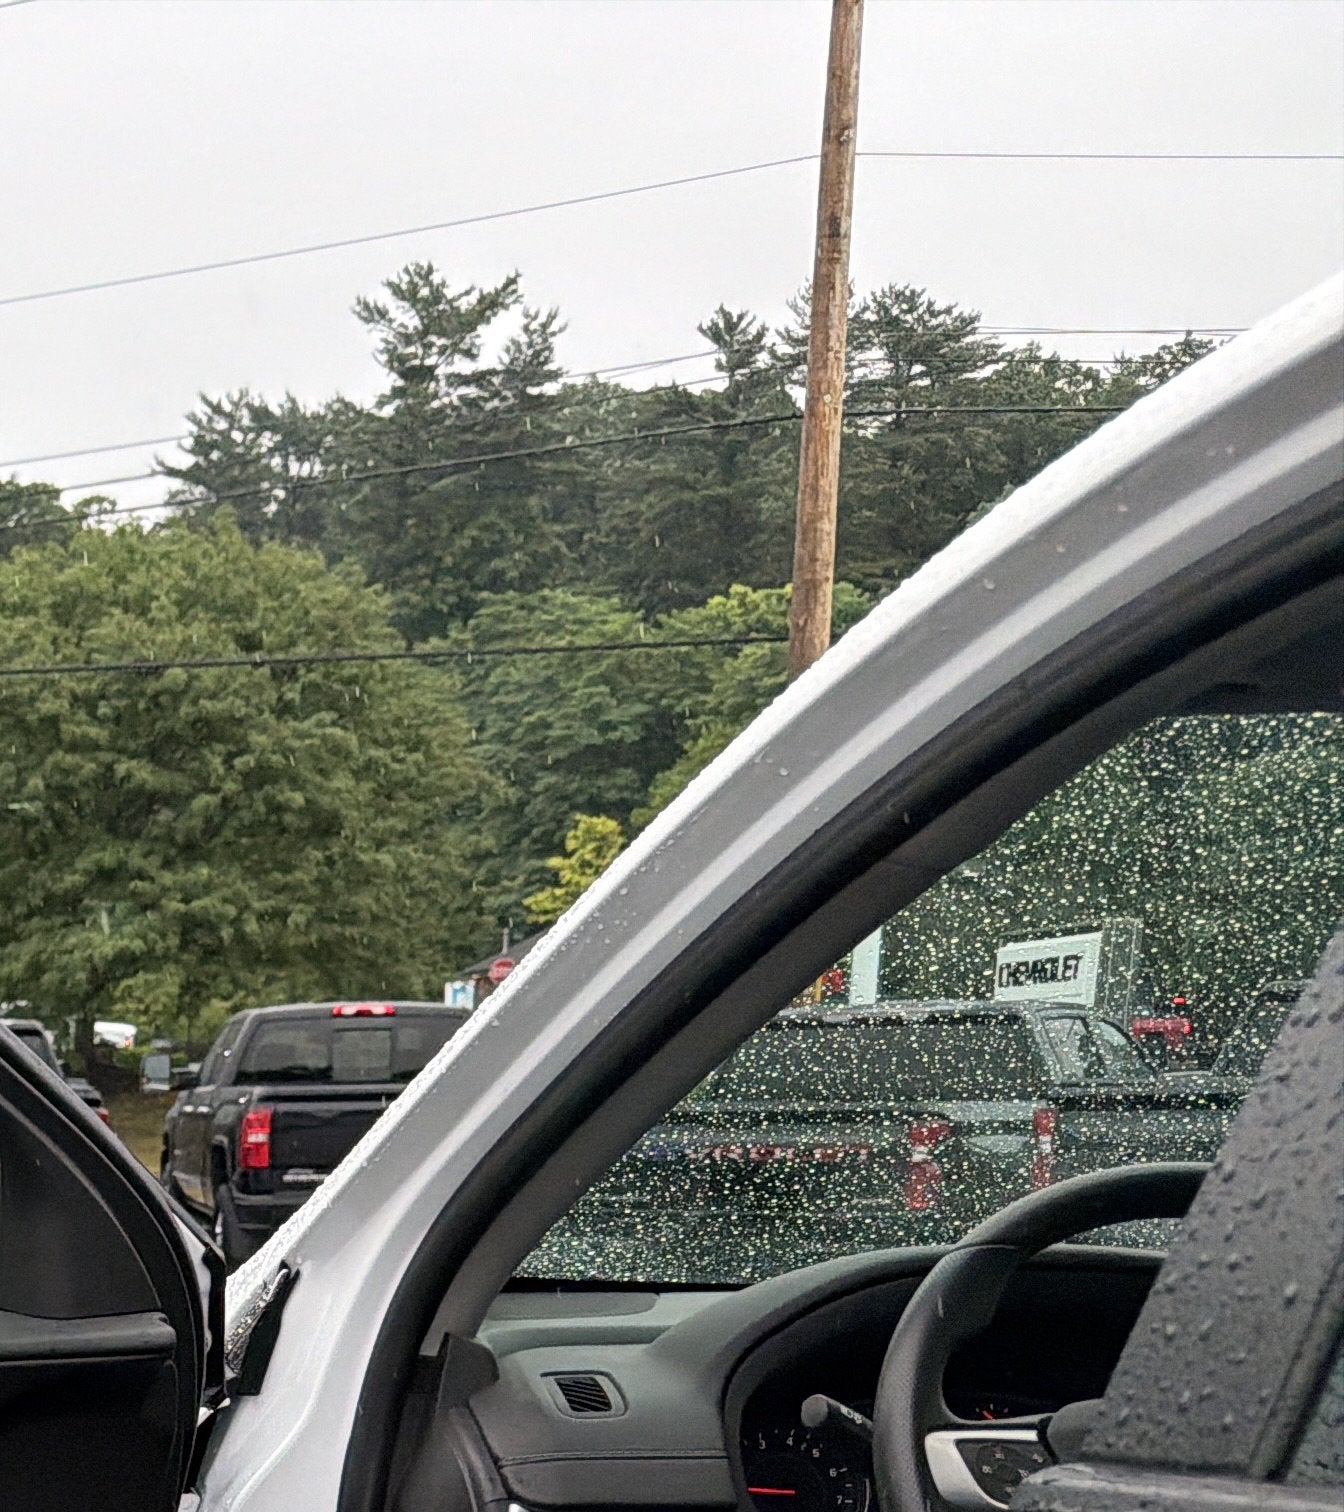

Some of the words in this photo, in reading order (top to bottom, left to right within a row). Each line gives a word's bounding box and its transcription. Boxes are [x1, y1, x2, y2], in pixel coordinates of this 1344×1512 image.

[759, 1440, 766, 1449] 3
[786, 1436, 793, 1446] 4
[812, 1449, 820, 1458] 5
[829, 1468, 837, 1477] 6
[836, 1495, 843, 1505] 7
